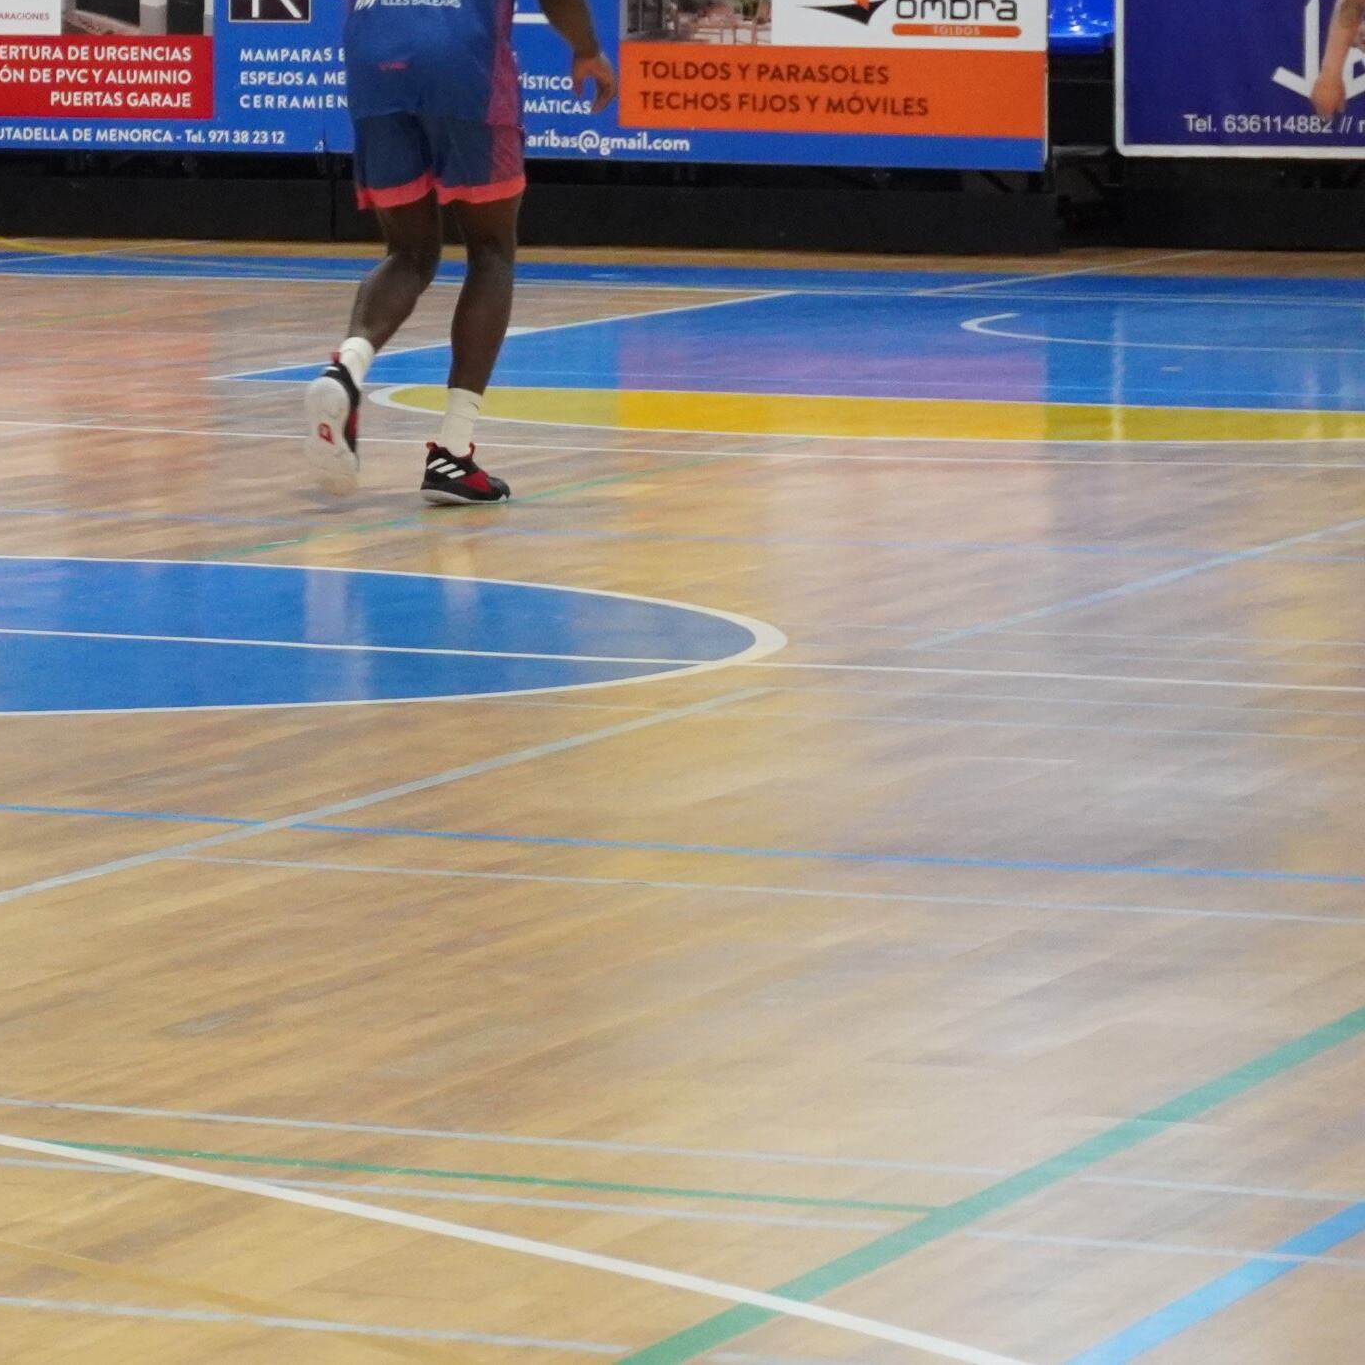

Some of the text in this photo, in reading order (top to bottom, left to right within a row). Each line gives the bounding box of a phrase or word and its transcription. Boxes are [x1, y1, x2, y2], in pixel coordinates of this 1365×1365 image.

[932, 25, 981, 36] TOLDOS
[68, 46, 89, 61] DE
[94, 46, 192, 62] URGENCIAS
[240, 48, 332, 62] MAMPARAS
[30, 68, 52, 83] DE
[56, 69, 88, 83] PVC
[91, 69, 103, 84] Y
[104, 69, 192, 85] ALUMINIO
[240, 71, 304, 85] ESPEJOS
[306, 72, 318, 86] A
[640, 59, 891, 85] TOLDOS Y PARASOLES
[50, 91, 192, 108] PUERTAS GARAJE
[640, 89, 929, 116] TECHOS FIJOS Y MÓVILES
[1183, 114, 1217, 133] Tel.
[1223, 114, 1333, 133] 636114882
[73, 128, 91, 142] DE
[94, 128, 173, 143] MENORCA
[185, 130, 205, 144] Tel.
[208, 130, 229, 144] 971
[232, 131, 249, 144] 38
[252, 131, 268, 144] 23
[271, 131, 285, 144] 12
